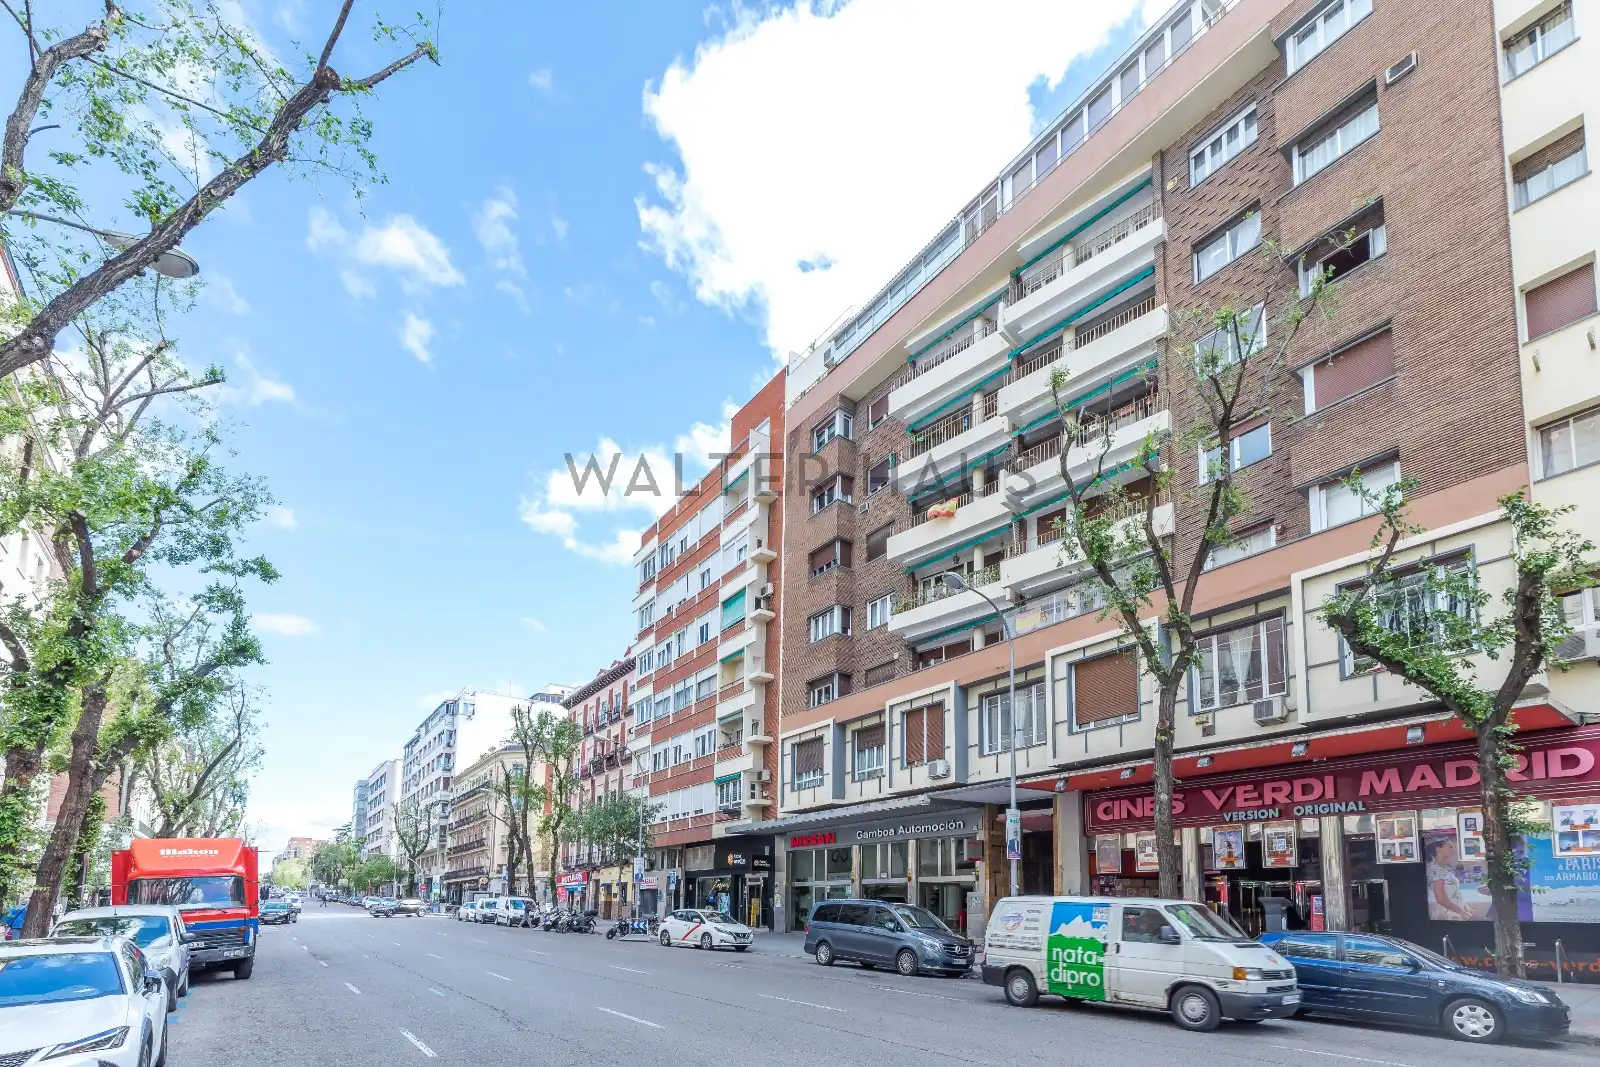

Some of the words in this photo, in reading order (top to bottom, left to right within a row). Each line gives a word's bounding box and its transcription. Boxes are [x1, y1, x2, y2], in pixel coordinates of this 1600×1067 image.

[1096, 792, 1186, 821] CINES
[1202, 775, 1335, 811] VERDI
[1358, 747, 1595, 796] MADRID
[1223, 807, 1279, 822] VERSION
[1293, 800, 1366, 816] ORIGINAL
[790, 832, 836, 848] NISSAN
[856, 828, 895, 840] Gamboa
[898, 819, 965, 835] Automoción
[1555, 871, 1598, 881] ARMARIO
[1052, 946, 1097, 966] nata
[1050, 961, 1101, 989] dipro
